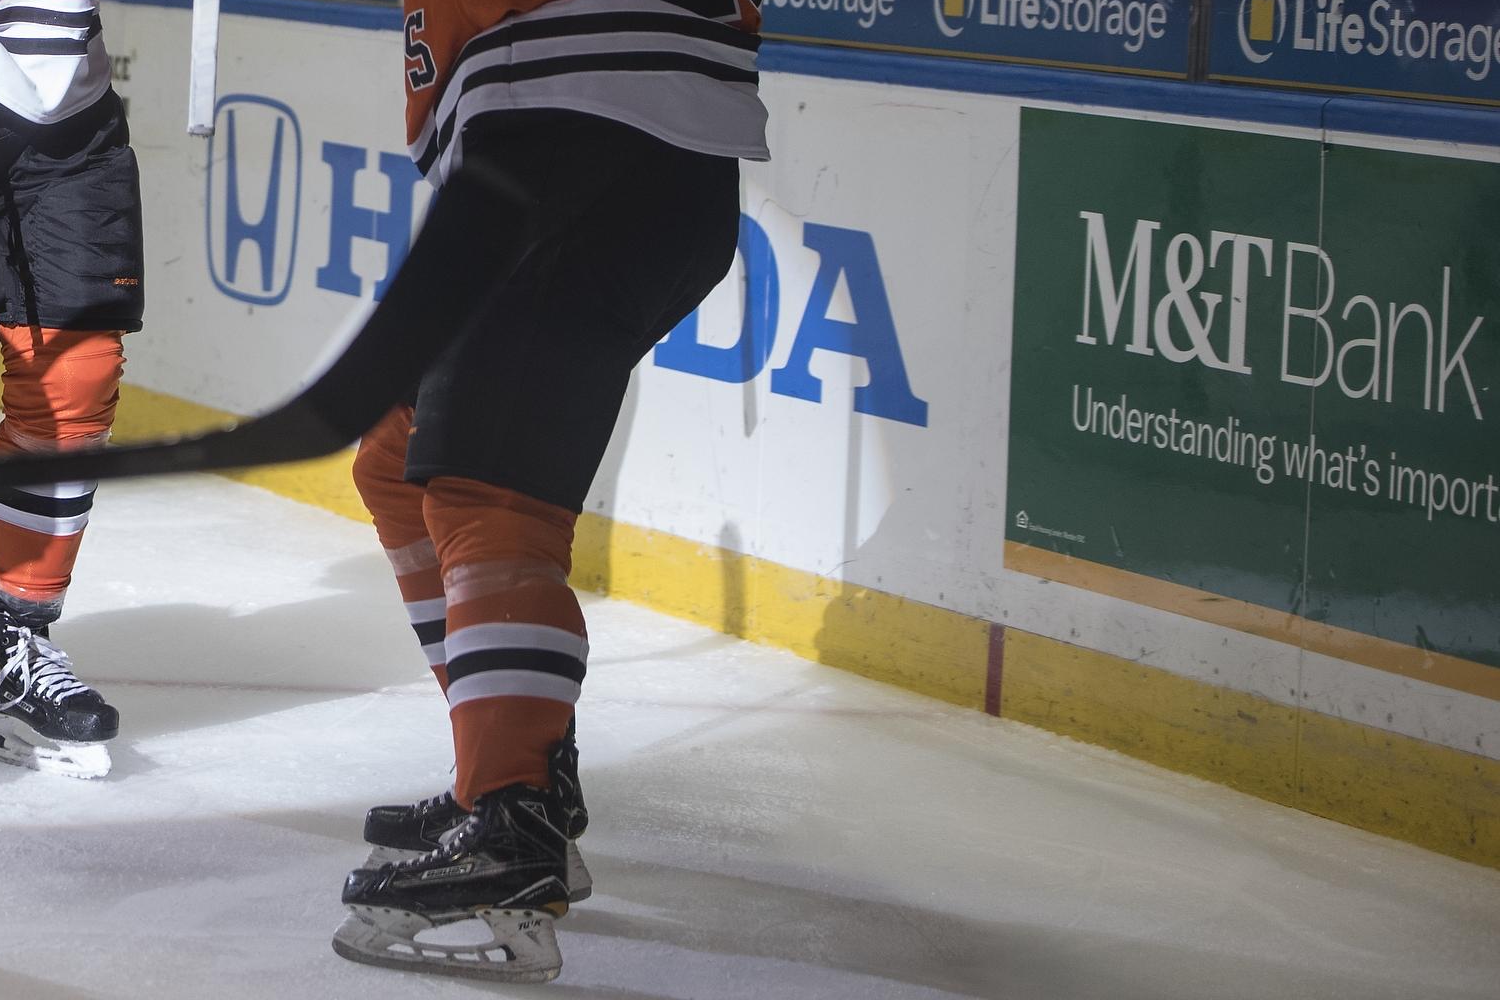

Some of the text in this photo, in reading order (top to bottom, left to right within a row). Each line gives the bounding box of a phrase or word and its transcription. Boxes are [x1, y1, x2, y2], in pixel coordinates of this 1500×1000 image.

[316, 140, 928, 428] HDA
[1076, 210, 1485, 421] M&T Bank
[1072, 384, 1500, 522] Understanding what's import
